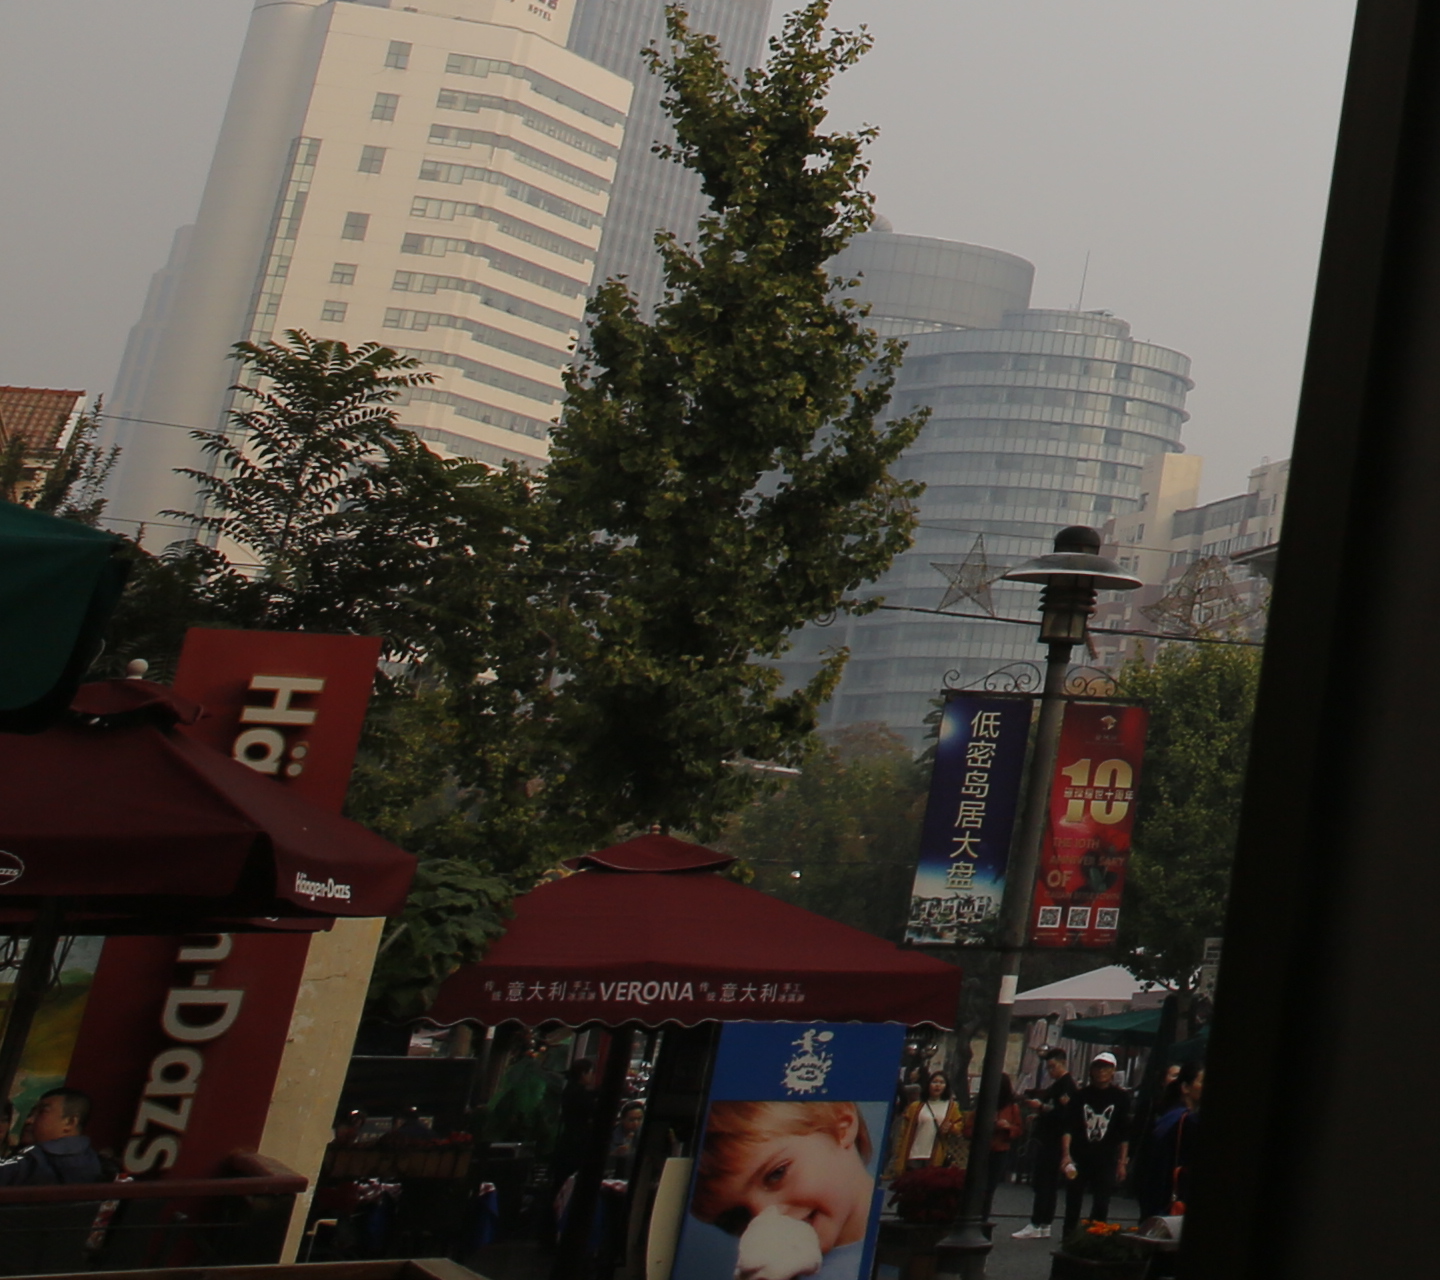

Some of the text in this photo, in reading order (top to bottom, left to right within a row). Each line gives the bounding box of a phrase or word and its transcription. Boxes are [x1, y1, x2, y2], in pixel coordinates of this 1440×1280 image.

[944, 709, 1002, 891] 低密岛居大盘
[1061, 758, 1133, 825] 10
[1046, 870, 1074, 888] OF
[505, 980, 568, 1002] 意大利
[599, 980, 695, 1005] VERONA
[719, 982, 779, 1003] 意大利
